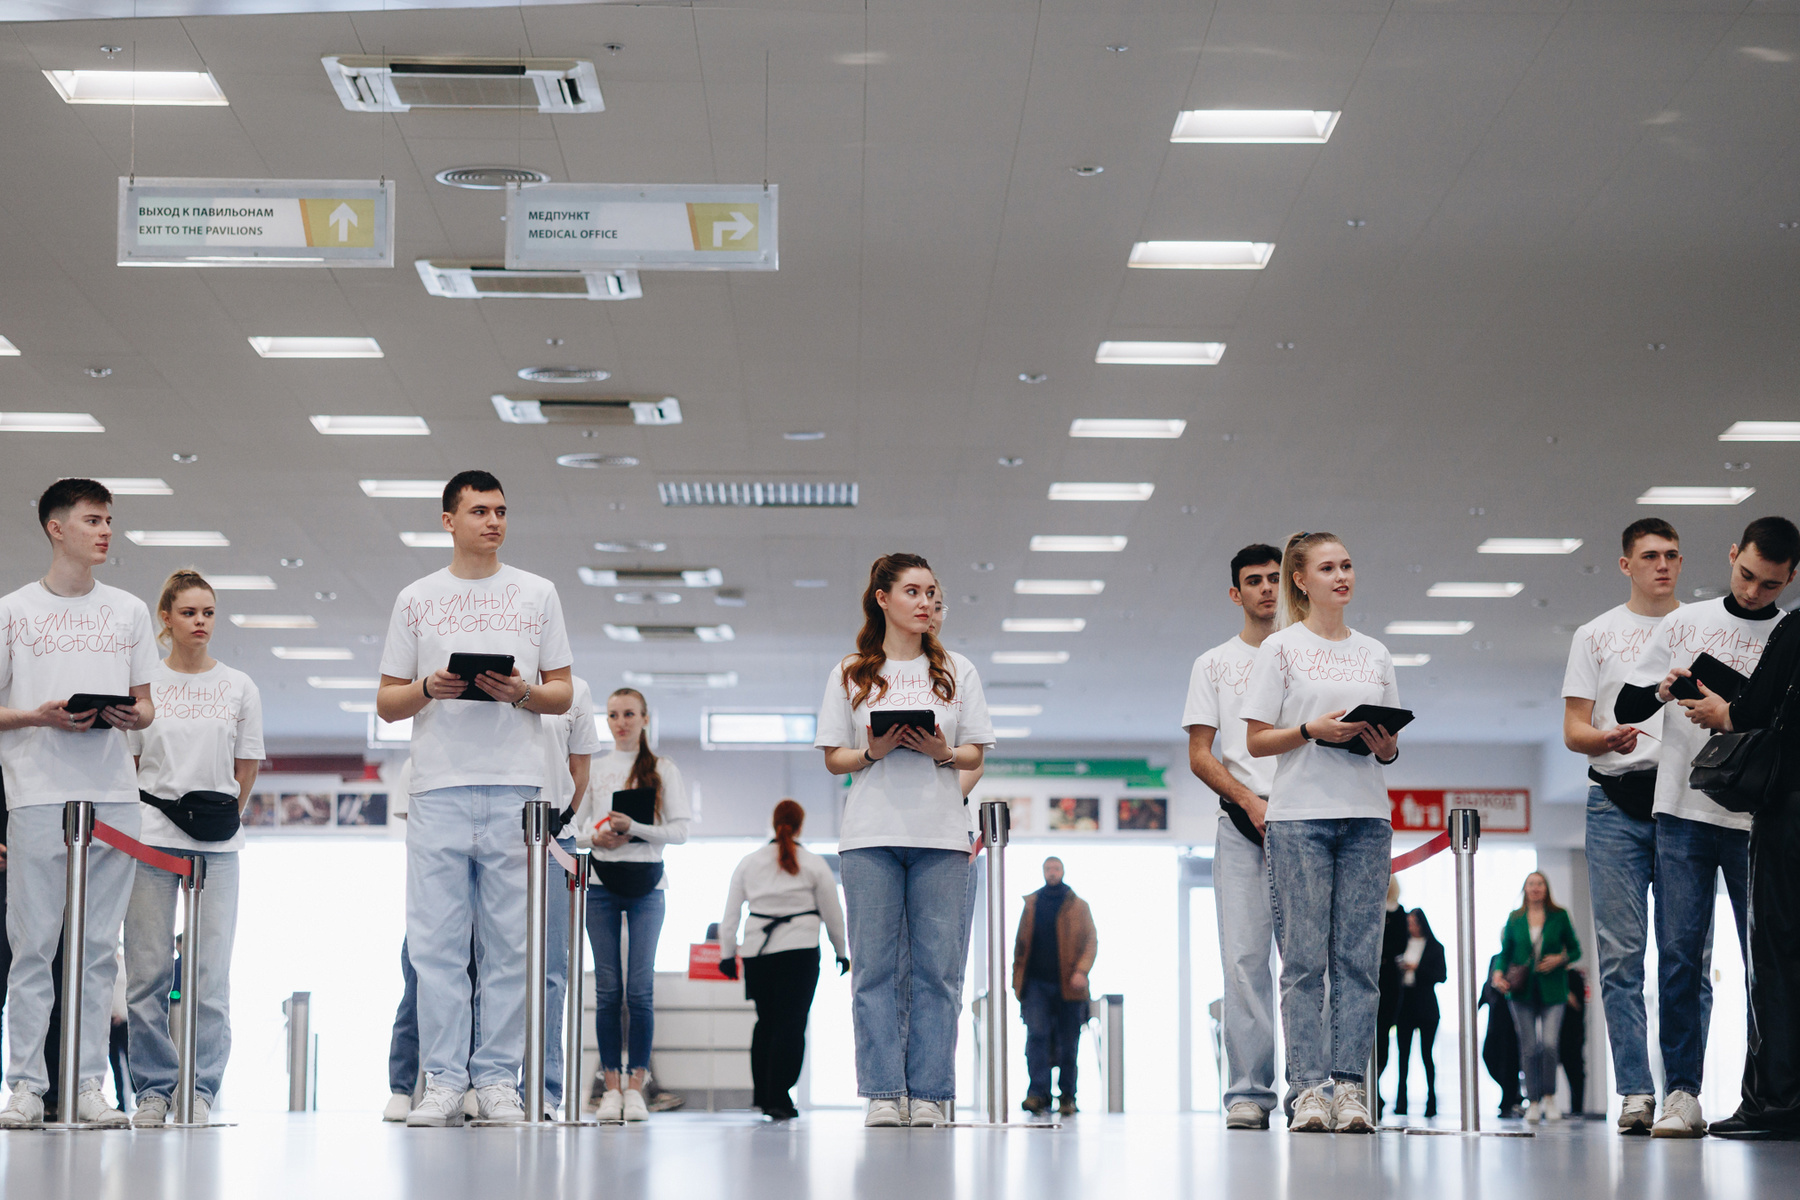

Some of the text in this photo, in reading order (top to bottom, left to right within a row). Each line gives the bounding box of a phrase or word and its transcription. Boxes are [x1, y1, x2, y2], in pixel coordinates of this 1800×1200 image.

[138, 206, 274, 219] ВЫХОД К ПАВИЛЬОНАМ
[528, 211, 590, 222] МЕДПУНКТ
[138, 225, 263, 236] EXIT TO THE PAVILIONS
[528, 229, 618, 240] MEDICAL OFFICE
[440, 584, 520, 626] УМНЫХ
